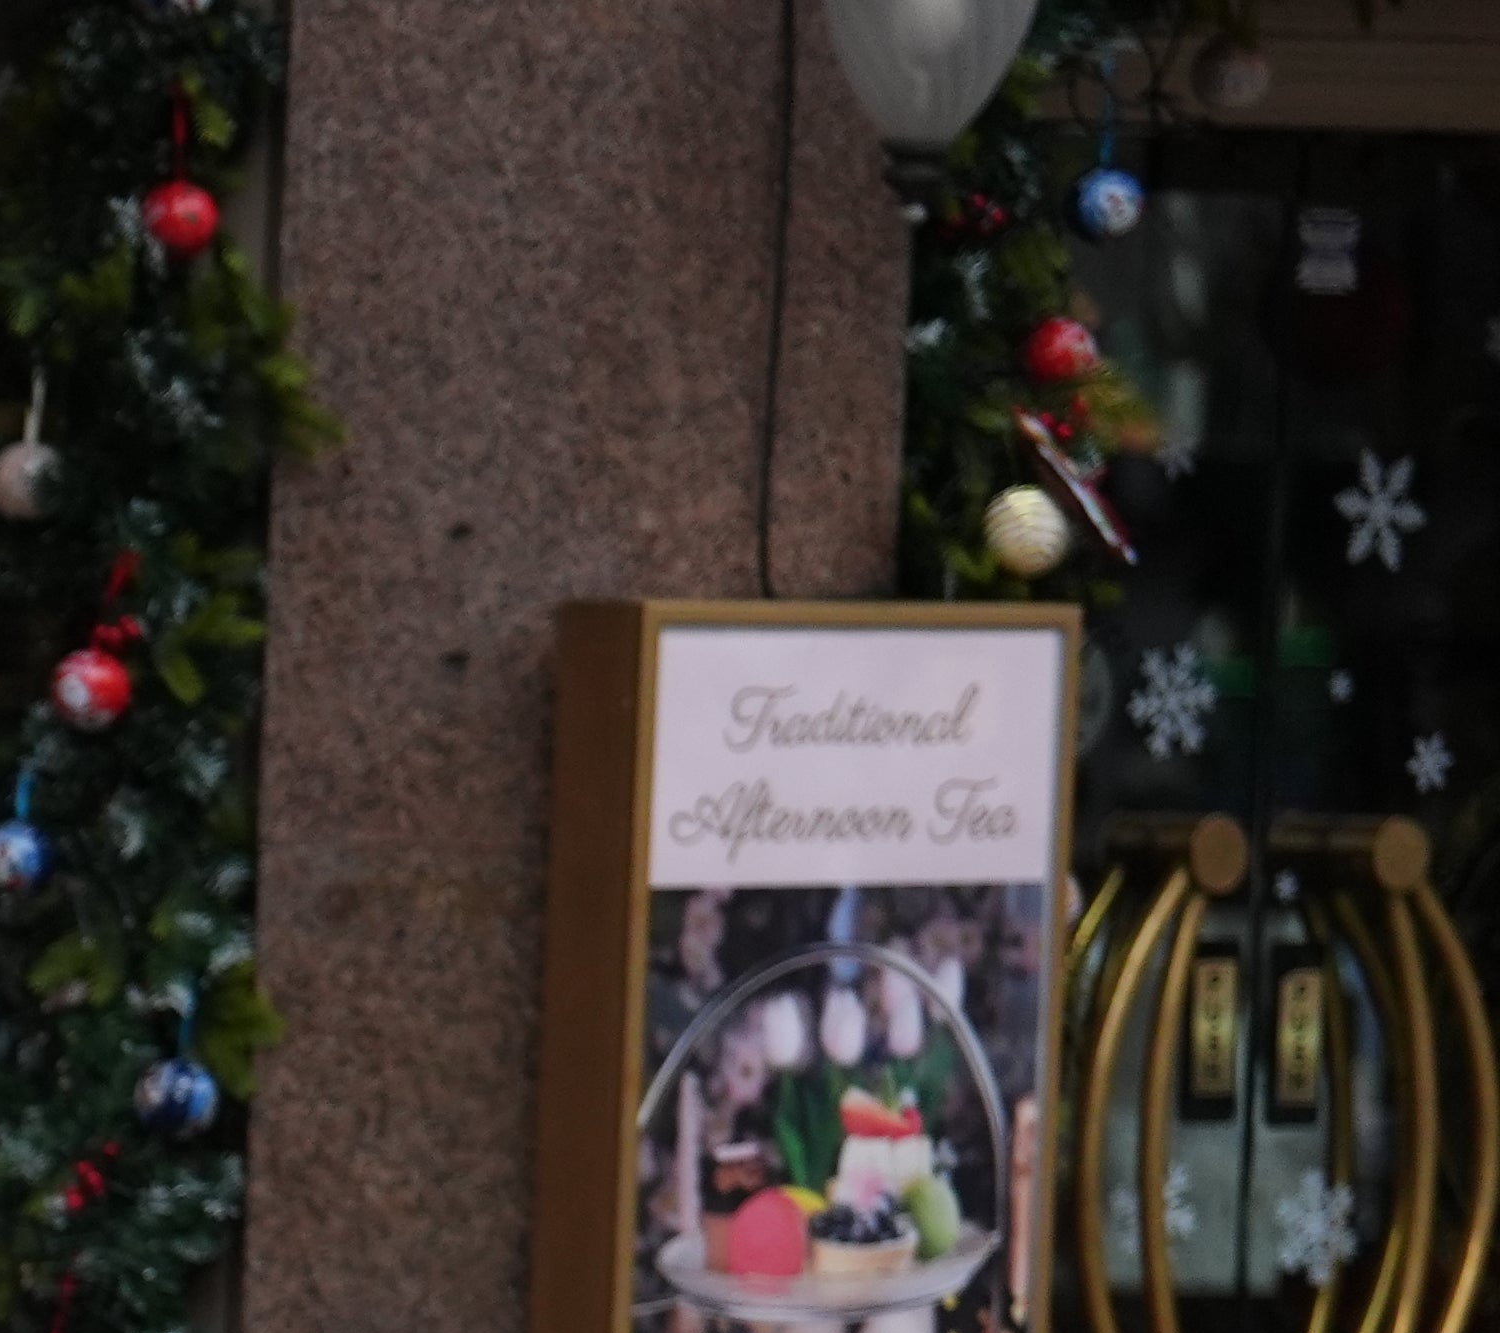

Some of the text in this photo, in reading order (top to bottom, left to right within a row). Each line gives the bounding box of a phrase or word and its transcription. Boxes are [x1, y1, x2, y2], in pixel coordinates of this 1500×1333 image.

[722, 680, 982, 754] Traditional
[667, 775, 1021, 866] Afternoon Tea
